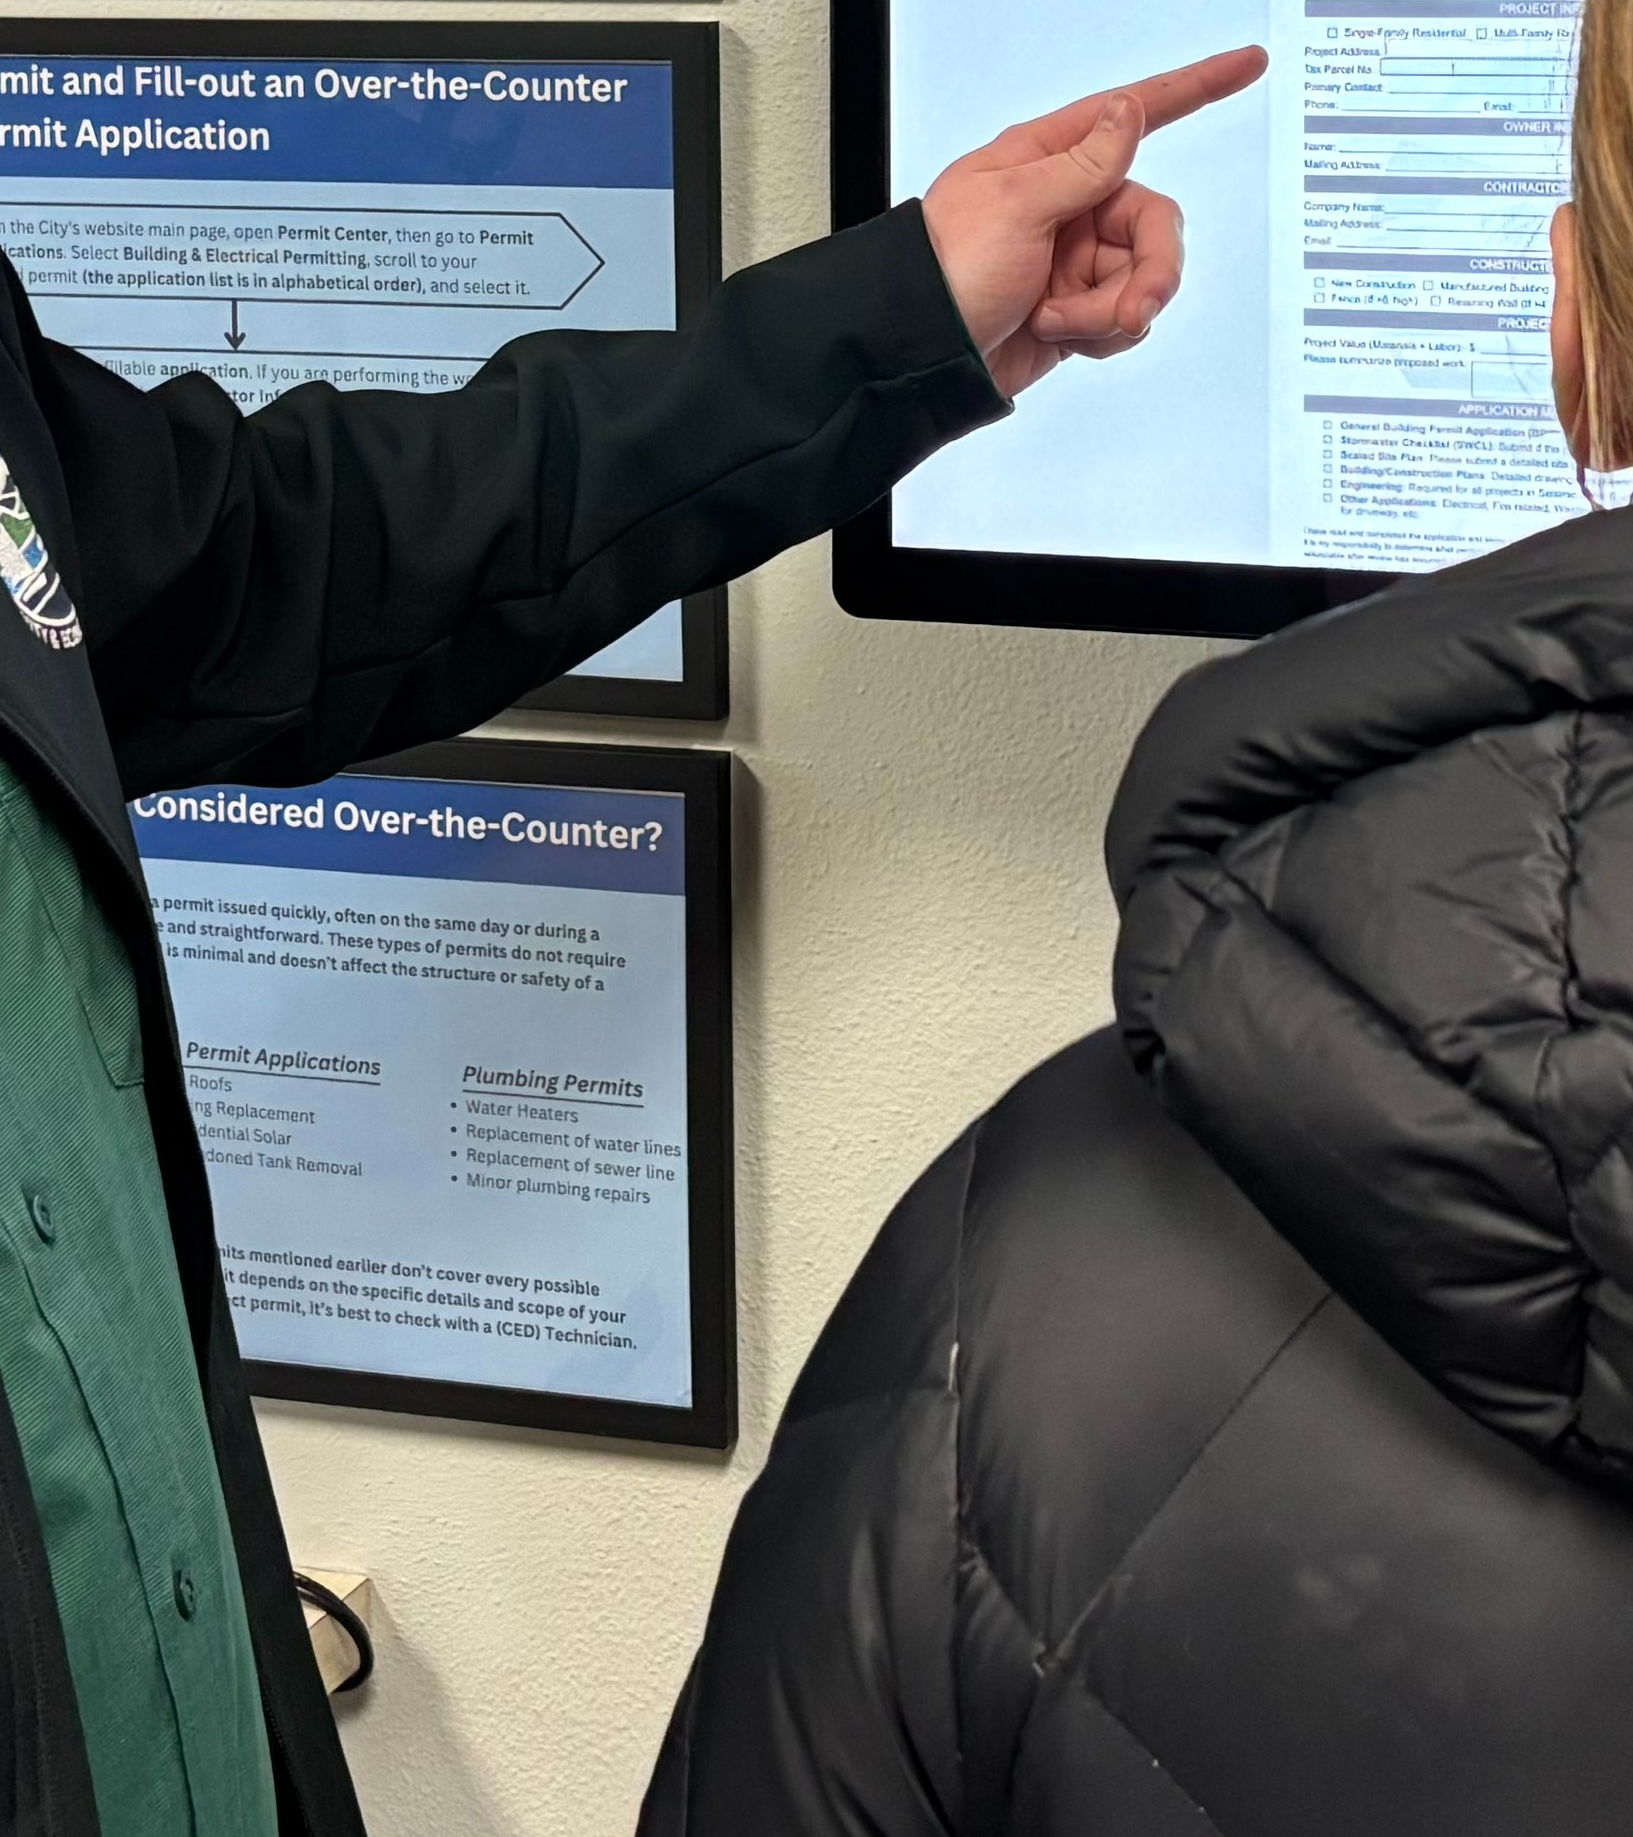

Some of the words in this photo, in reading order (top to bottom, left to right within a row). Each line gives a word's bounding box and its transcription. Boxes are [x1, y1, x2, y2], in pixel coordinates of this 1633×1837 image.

[1499, 3, 1557, 15] PROJECT
[61, 64, 124, 95] and
[134, 64, 256, 97] Fill-out
[263, 74, 304, 98] an
[314, 67, 628, 102] Over-the-Counter
[74, 117, 269, 156] Application
[1503, 121, 1551, 133] OWNER
[9, 218, 34, 234] the
[38, 219, 80, 238] City's
[84, 221, 144, 236] website
[148, 224, 184, 237] main
[189, 225, 230, 242] page,
[233, 226, 273, 242] open
[277, 224, 330, 241] Permit
[333, 226, 391, 244] Center,
[395, 227, 430, 243] then
[434, 231, 454, 247] go
[457, 230, 475, 244] to
[479, 229, 534, 245] Permit
[3, 242, 67, 260] ications.
[70, 244, 118, 260] Select
[122, 245, 188, 265] Building
[190, 246, 202, 262] &
[205, 246, 279, 264] Electrical
[282, 249, 370, 270] Permitting,
[374, 251, 417, 268] scroll
[420, 253, 437, 268] to
[441, 256, 477, 272] your
[28, 270, 78, 285] permit
[82, 268, 113, 285] (the
[116, 270, 205, 289] application
[209, 271, 233, 287] list
[236, 272, 249, 287] is
[252, 272, 267, 288] in
[271, 272, 370, 292] alphabetical
[373, 275, 426, 295] order),
[429, 278, 459, 293] and
[463, 278, 510, 295] select
[515, 279, 530, 295] it.
[1497, 318, 1546, 330] PROJEC
[257, 364, 267, 379] If
[271, 368, 299, 383] you
[304, 368, 329, 381] are
[333, 367, 419, 388] performing
[423, 369, 448, 385] the
[1458, 404, 1538, 417] APPLICATION
[132, 791, 323, 828] Considered
[333, 800, 662, 851] Over-the-Counter?
[162, 897, 214, 913] permit
[217, 898, 267, 916] issued
[270, 903, 330, 925] quickly,
[333, 907, 376, 924] often
[379, 914, 400, 927] on
[403, 912, 430, 929] the
[434, 917, 476, 932] same
[479, 917, 509, 937] day
[512, 923, 531, 935] or
[533, 921, 587, 944] during
[589, 929, 600, 941] a
[187, 1041, 251, 1063] Permit
[253, 1047, 381, 1076] Applications
[188, 1073, 232, 1092] Roofs
[462, 1065, 559, 1095] Plumbing
[563, 1073, 643, 1098] Permits
[215, 1100, 315, 1124] Replacement
[465, 1099, 513, 1116] Water
[517, 1103, 579, 1123] Heaters
[198, 1123, 250, 1142] dential
[252, 1127, 292, 1145] Solar
[465, 1122, 570, 1147] Replacement
[573, 1132, 591, 1148] of
[593, 1137, 640, 1153] water
[643, 1138, 681, 1157] lines
[207, 1148, 253, 1166] doned
[256, 1152, 292, 1169] Tank
[295, 1155, 362, 1176] Removal
[466, 1147, 570, 1172] Replacement
[573, 1157, 590, 1173] of
[593, 1162, 641, 1177] sewer
[645, 1163, 675, 1181] line
[466, 1172, 512, 1189] Minor
[516, 1177, 591, 1202] plumbing
[594, 1186, 651, 1204] repairs
[249, 1297, 306, 1316] permit,
[309, 1300, 333, 1317] it's
[336, 1302, 371, 1321] best
[373, 1309, 391, 1323] to
[394, 1310, 441, 1328] check
[443, 1315, 479, 1332] with
[482, 1321, 492, 1334] a
[495, 1320, 540, 1340] (CED)
[543, 1325, 637, 1349] Technician.
